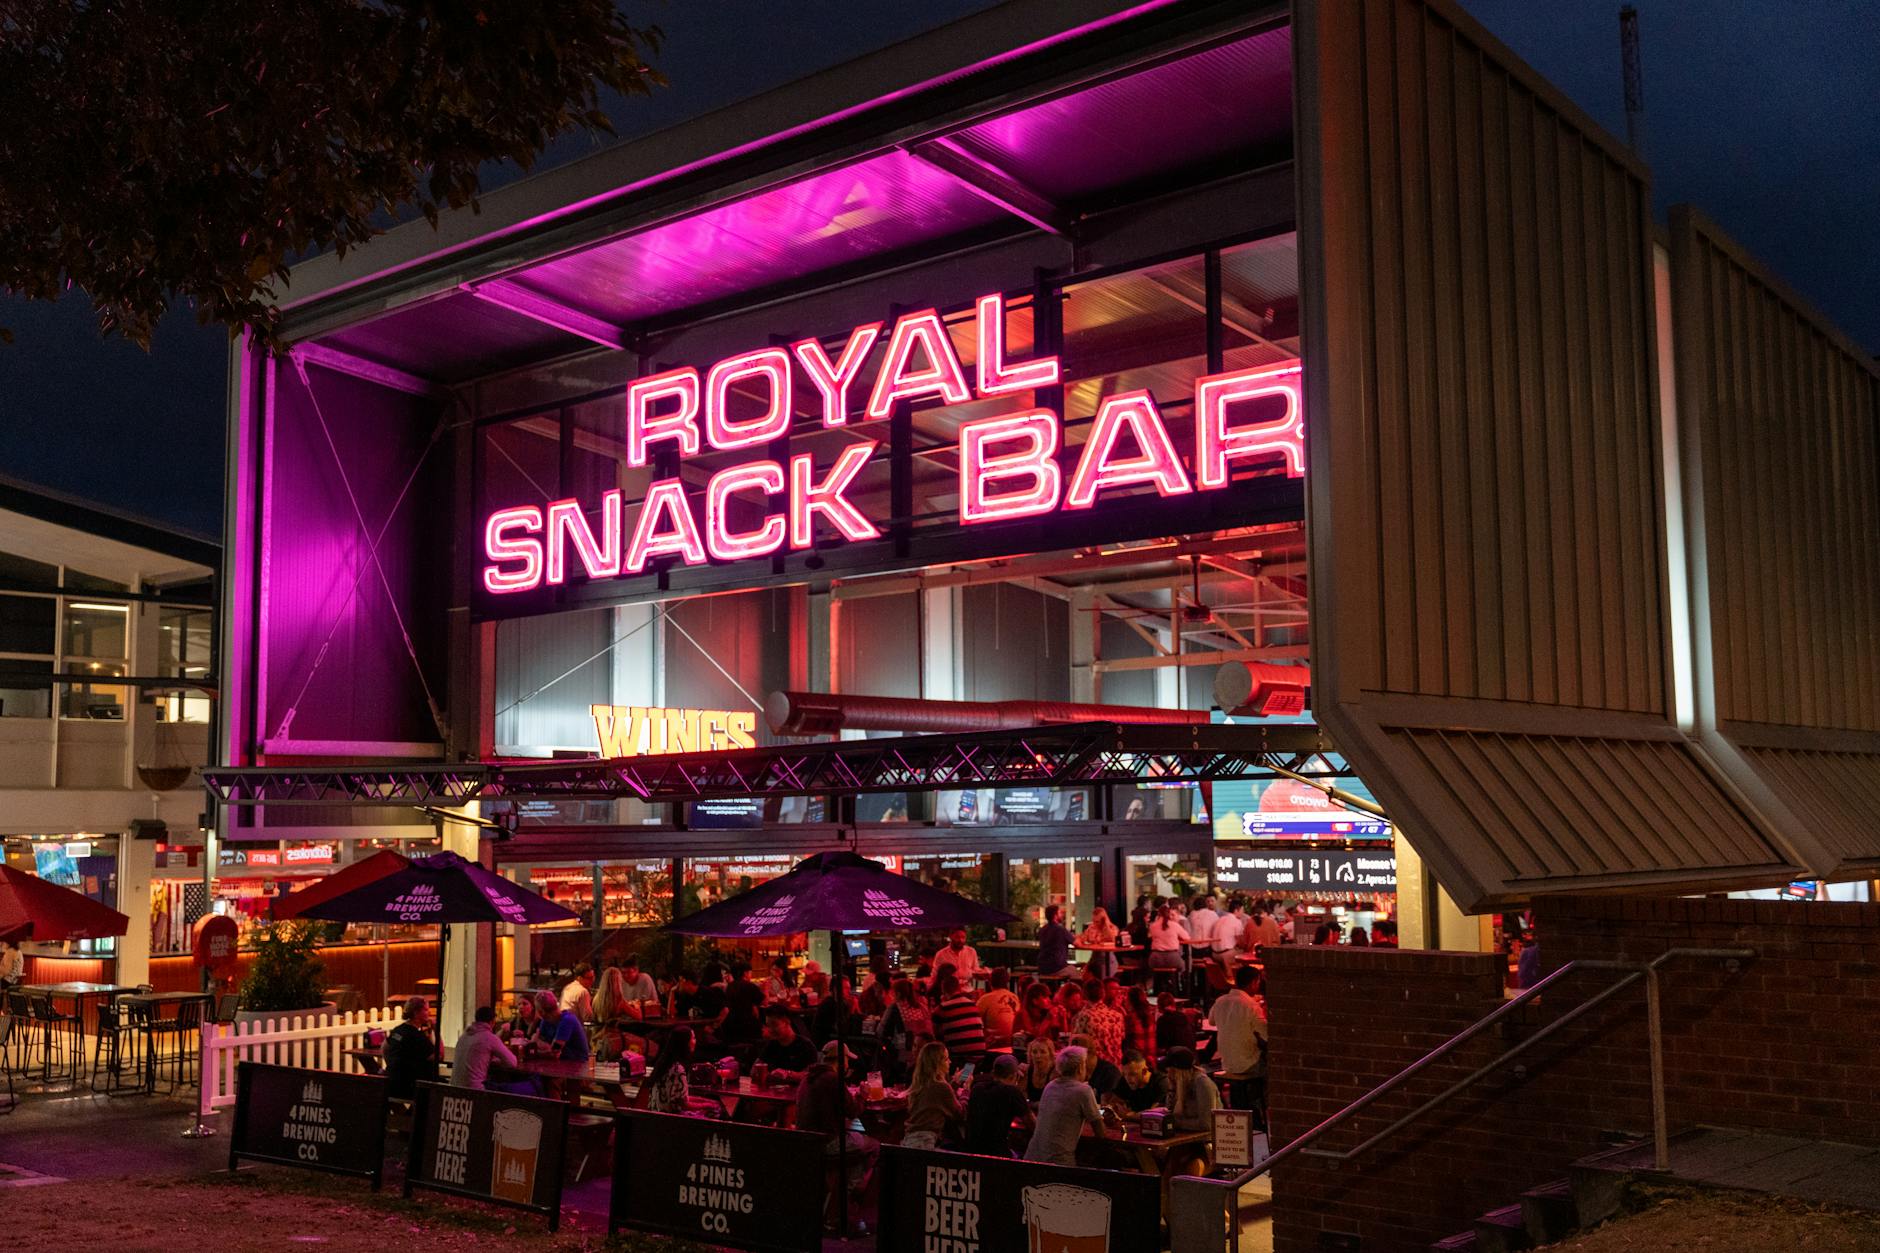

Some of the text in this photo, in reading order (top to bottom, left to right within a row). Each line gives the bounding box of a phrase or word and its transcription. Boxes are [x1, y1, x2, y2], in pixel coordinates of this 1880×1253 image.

[626, 292, 1063, 468] ROYAL
[484, 358, 1306, 594] SNACK BAR
[589, 704, 757, 760] WINGS
[385, 903, 443, 912] BREWING
[394, 895, 440, 903] 4 PINES
[863, 906, 924, 917] BREWING
[399, 912, 422, 921] CO.
[891, 916, 917, 925] CO.
[289, 1105, 331, 1124] 4 PINES
[441, 1096, 474, 1124] FRESH
[283, 1122, 337, 1144] BREWING
[437, 1121, 470, 1154] BEER
[298, 1144, 319, 1161] CO.
[434, 1151, 468, 1185] HERE
[687, 1164, 744, 1189] 4 PINES
[926, 1166, 981, 1201] FRESH
[679, 1184, 753, 1214] BREWING
[701, 1211, 730, 1234] CO.
[925, 1197, 980, 1240] BEER
